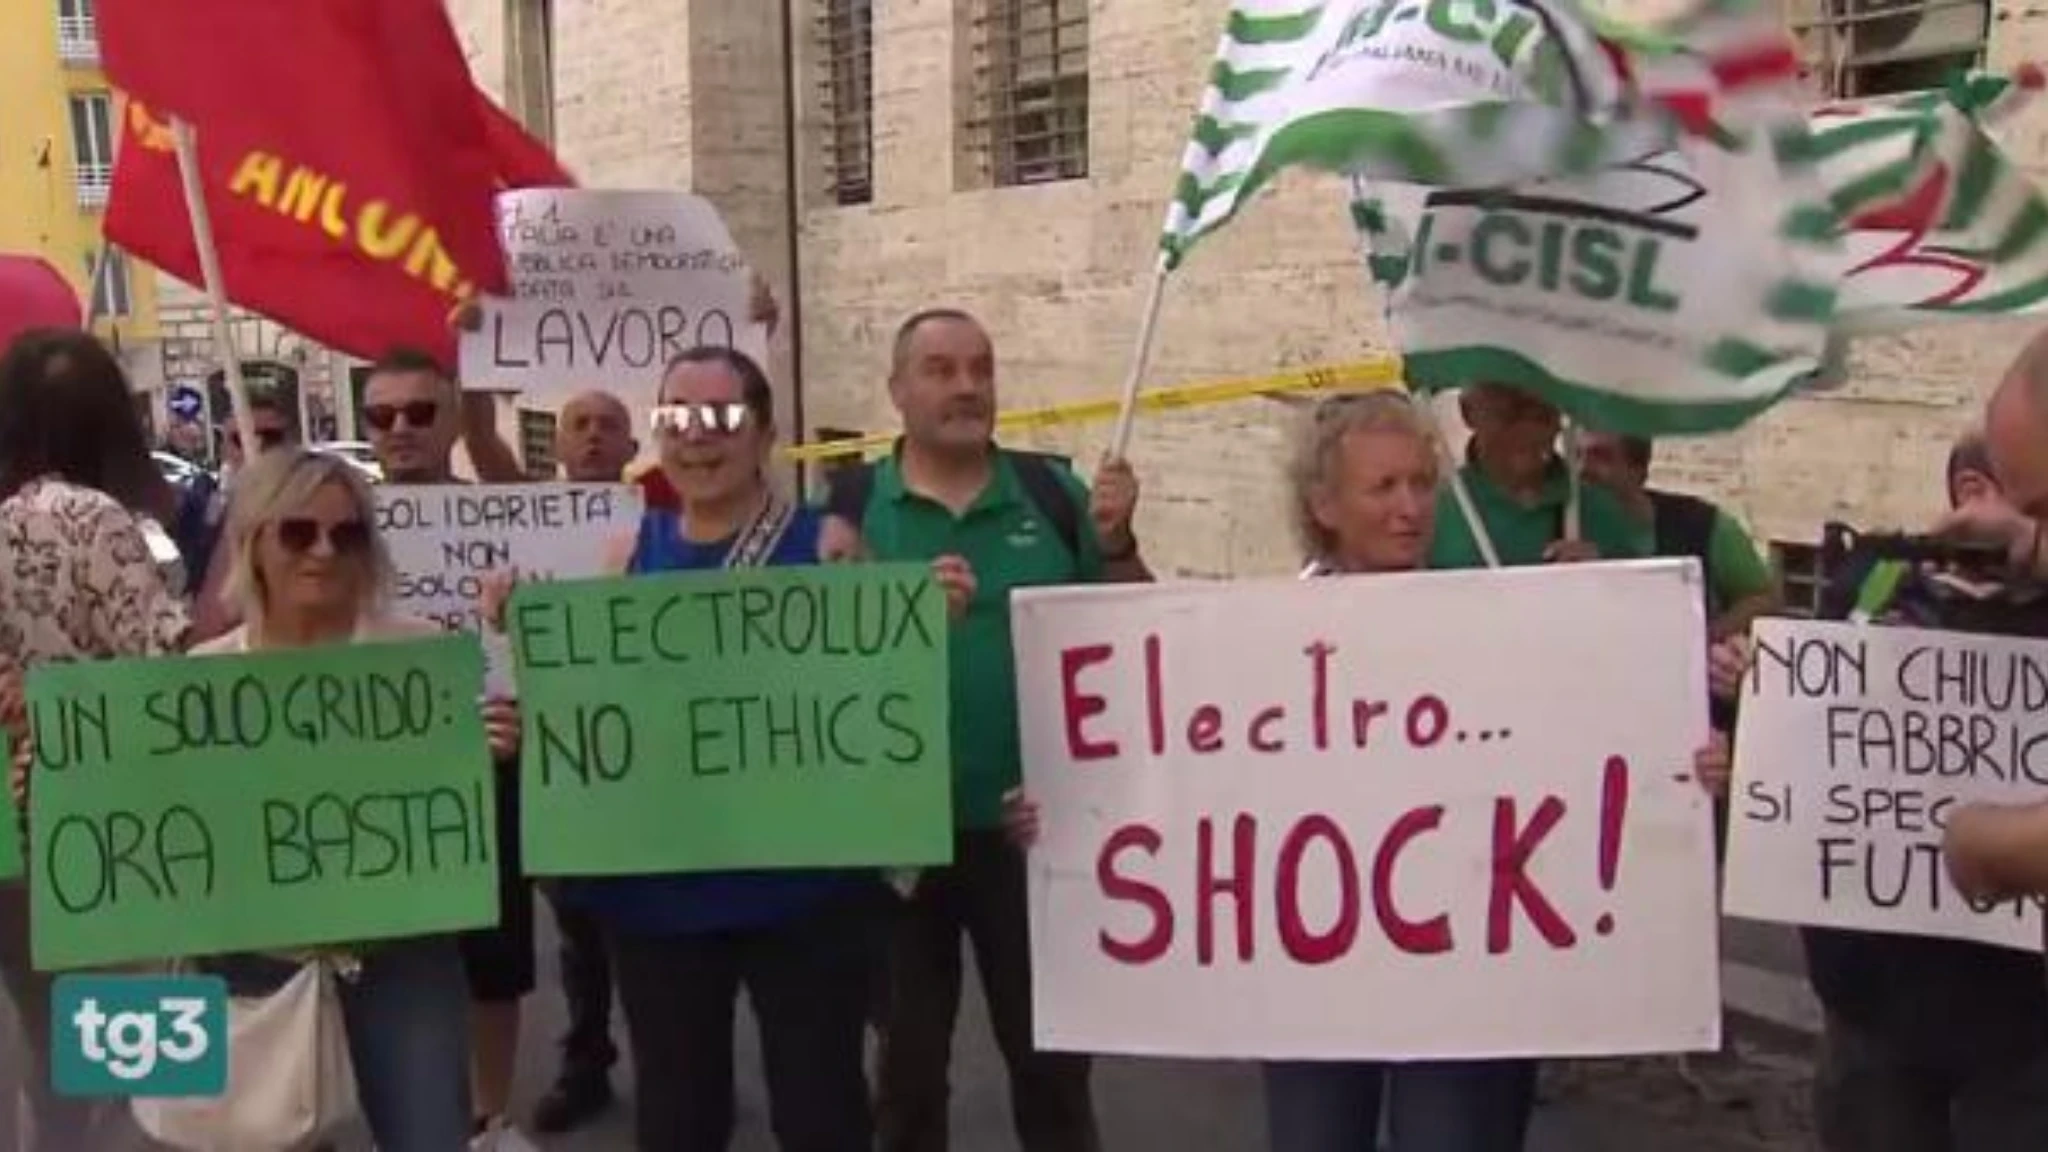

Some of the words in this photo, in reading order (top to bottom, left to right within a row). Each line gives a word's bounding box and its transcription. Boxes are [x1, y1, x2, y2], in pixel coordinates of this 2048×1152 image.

[441, 540, 510, 571] NON
[518, 577, 934, 669] ELECTROLUX
[1752, 634, 1868, 698] NON
[33, 694, 112, 771] UN
[147, 673, 272, 756] SOLO
[283, 668, 454, 747] GRIDO:
[536, 703, 635, 788] NO
[688, 691, 926, 777] ETHICS
[1060, 633, 1512, 762] Electro...
[1824, 705, 2048, 787] FABBRIC
[1745, 780, 1793, 825] SI
[1824, 783, 1957, 833] SPEC
[47, 804, 215, 914] ORA
[1097, 754, 1630, 968] SHOCK!
